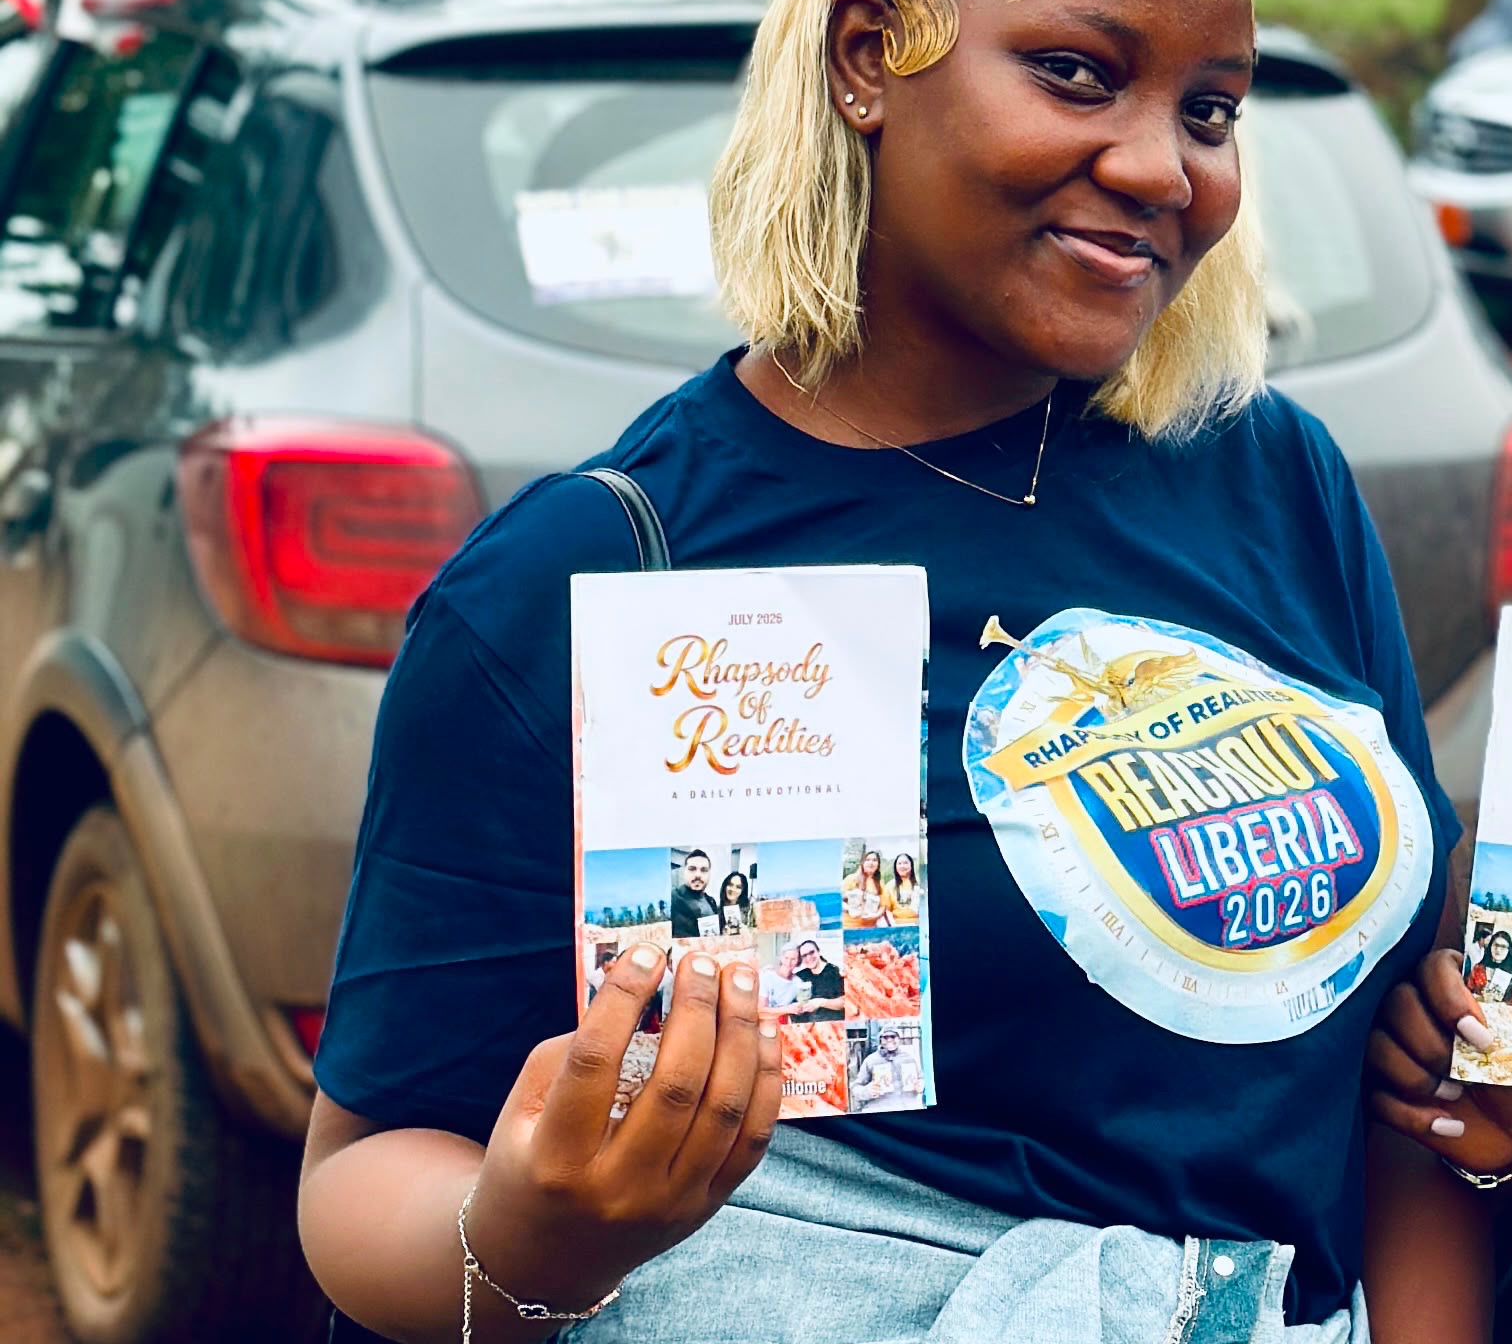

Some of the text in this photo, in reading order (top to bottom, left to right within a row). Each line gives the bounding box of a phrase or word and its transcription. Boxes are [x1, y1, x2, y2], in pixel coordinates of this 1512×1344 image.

[728, 613, 753, 625] JULY
[649, 634, 832, 700] Rhapsody
[665, 704, 836, 775] Realities
[738, 690, 773, 725] Of
[1023, 688, 1294, 768] RHAPY OF REALITIES
[690, 788, 734, 799] DAILY
[745, 784, 841, 797] DEVOTIONAL
[1078, 712, 1340, 832] REACHOUT
[1154, 794, 1358, 901] LIBERIA
[1226, 872, 1330, 942] 2026
